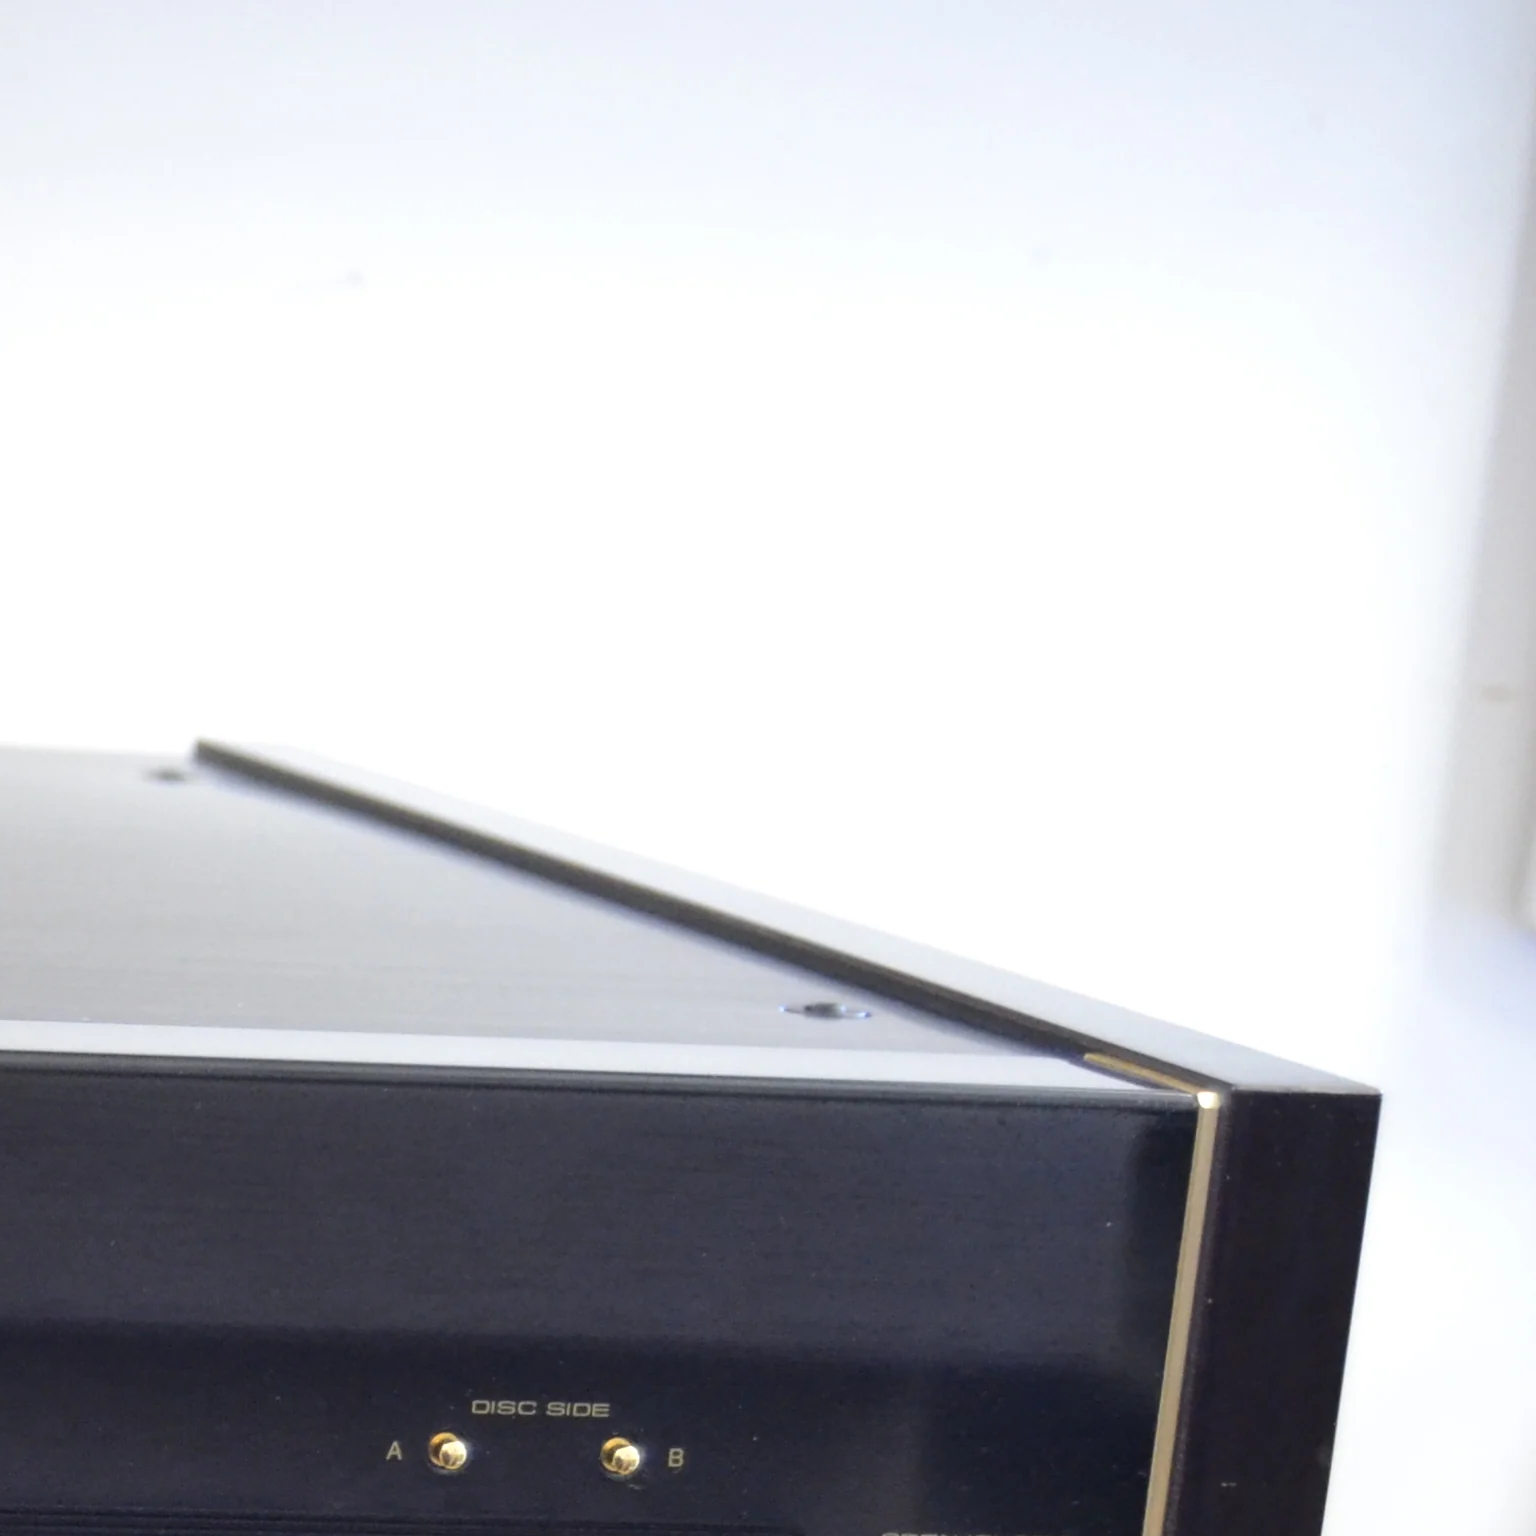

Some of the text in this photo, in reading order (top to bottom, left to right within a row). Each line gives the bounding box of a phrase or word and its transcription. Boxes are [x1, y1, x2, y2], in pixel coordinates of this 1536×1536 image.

[471, 1399, 611, 1418] DISC SIDE
[386, 1440, 403, 1461] A
[667, 1447, 685, 1468] B
